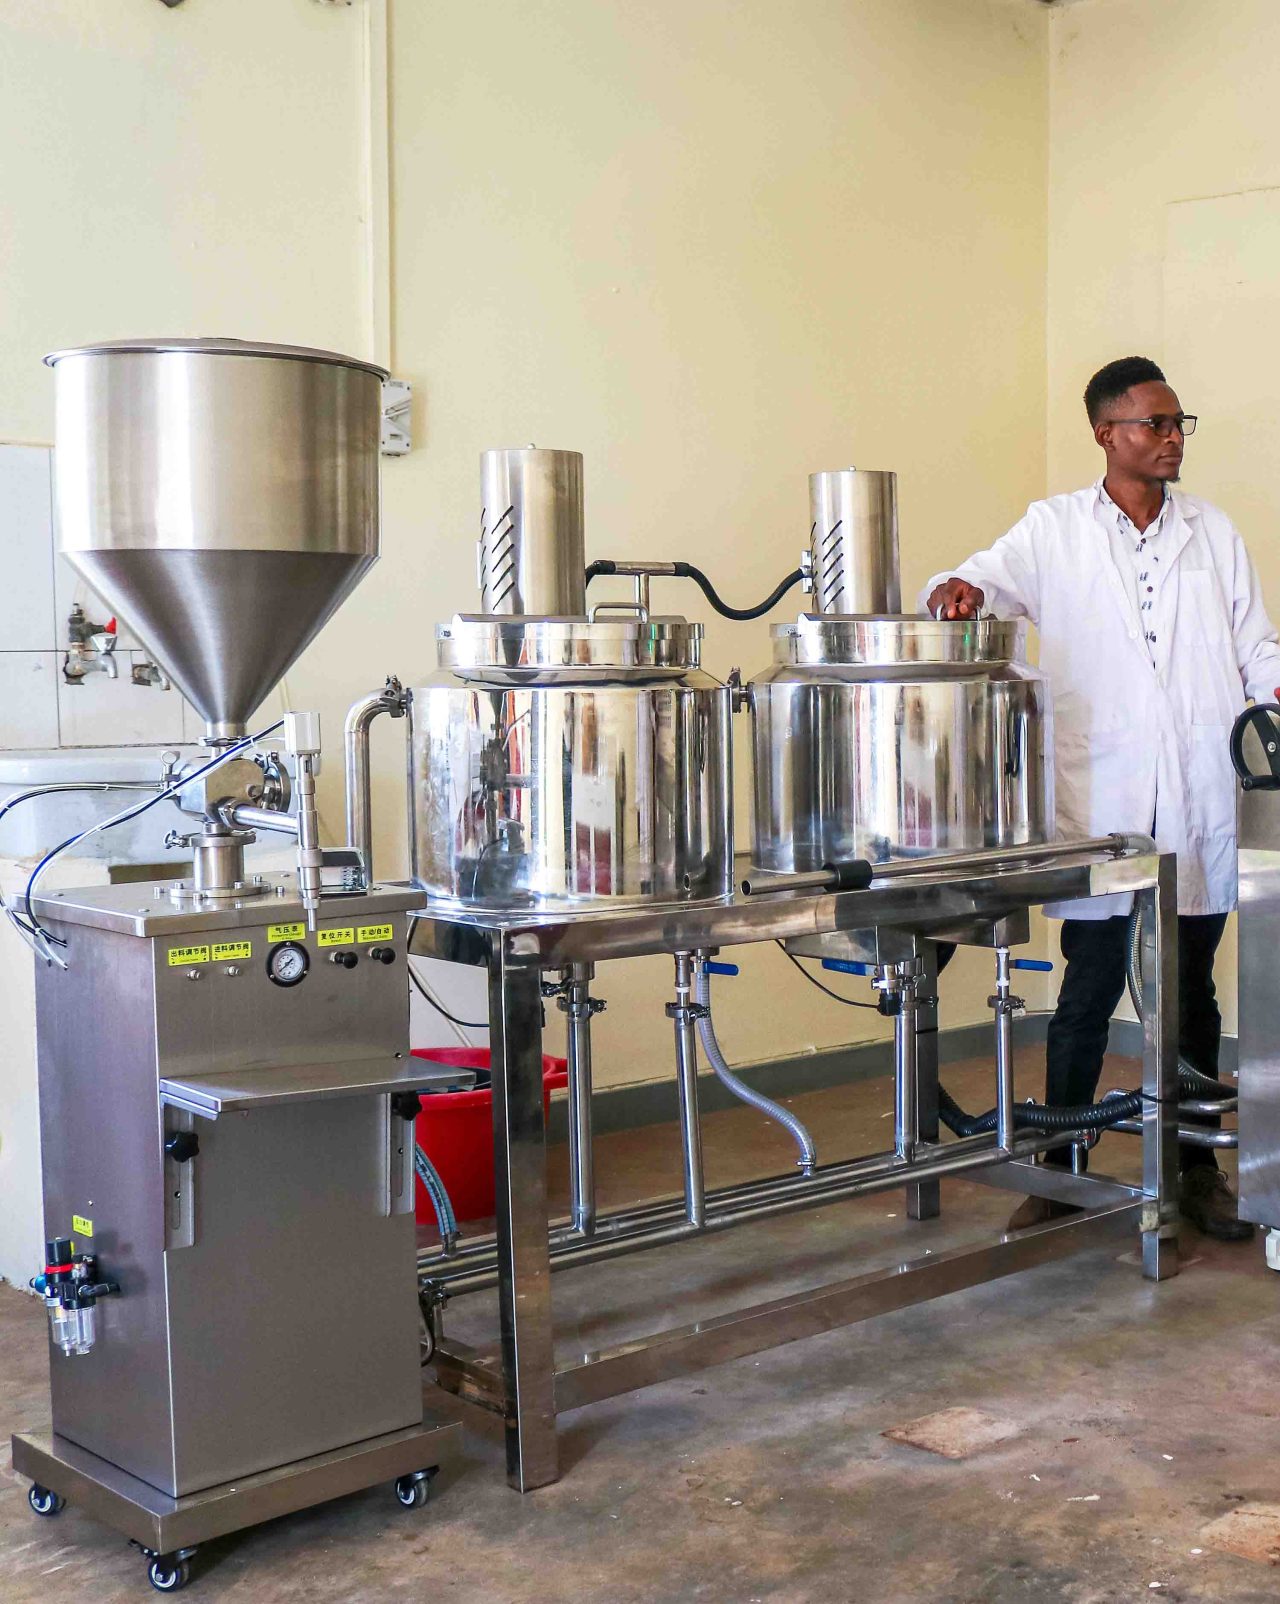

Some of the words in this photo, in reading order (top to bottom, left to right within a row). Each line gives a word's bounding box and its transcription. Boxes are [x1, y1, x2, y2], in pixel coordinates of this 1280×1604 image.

[275, 925, 298, 934] 气压表
[361, 927, 390, 936] 手动/自动
[321, 931, 351, 940] 复位开关
[171, 946, 207, 957] 出料调节阀
[214, 943, 249, 952] 进料调节阀
